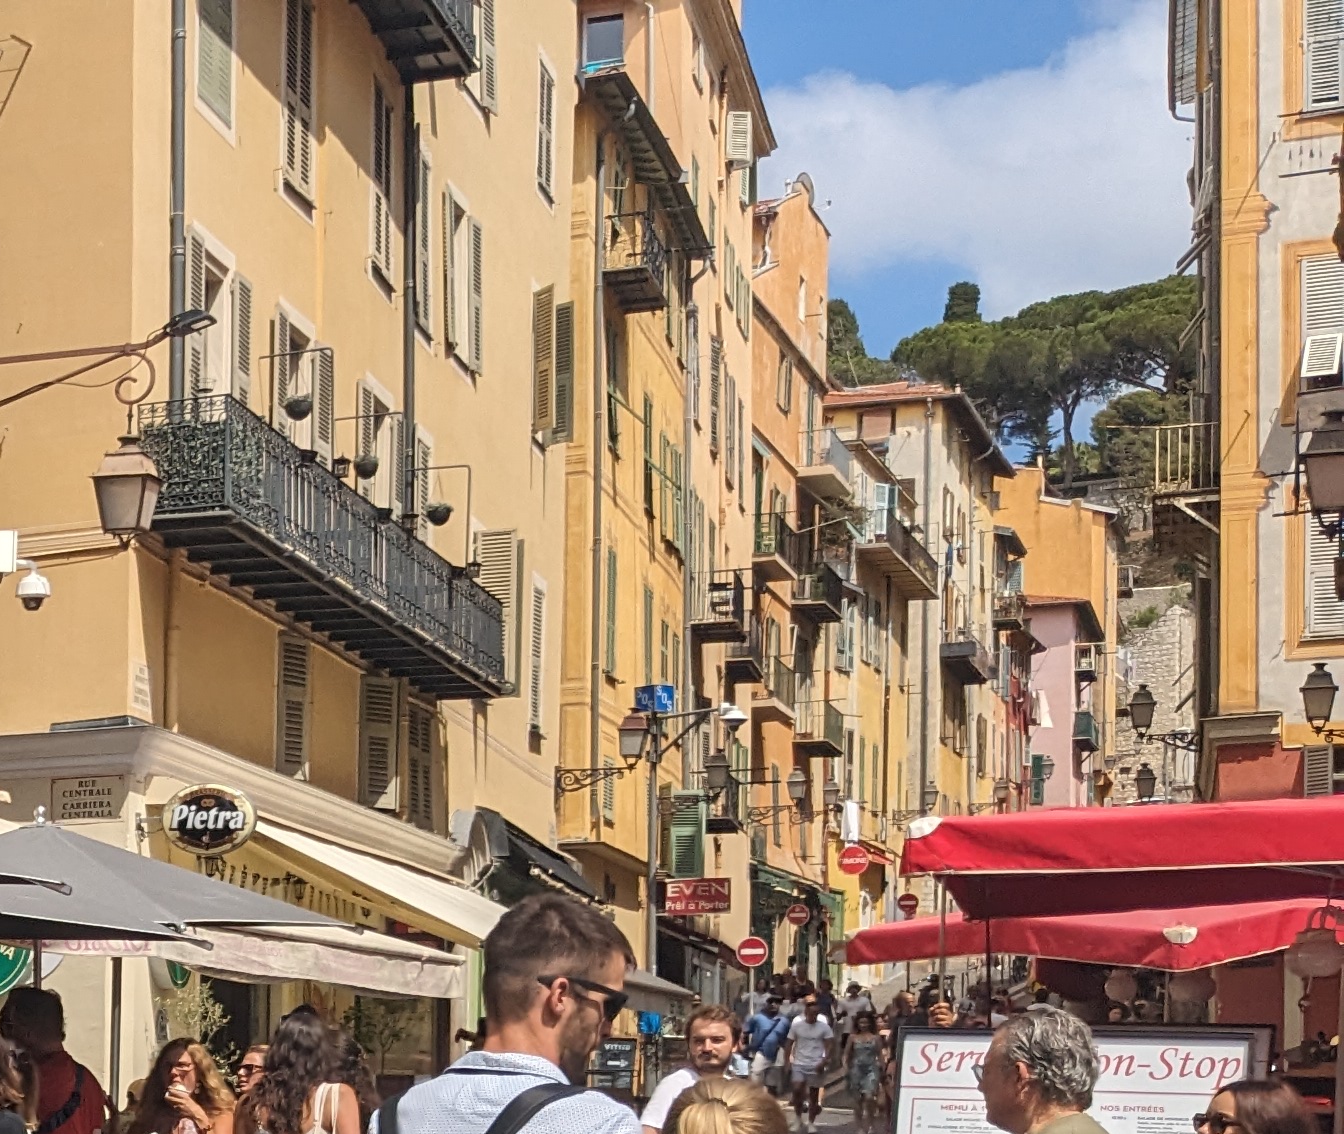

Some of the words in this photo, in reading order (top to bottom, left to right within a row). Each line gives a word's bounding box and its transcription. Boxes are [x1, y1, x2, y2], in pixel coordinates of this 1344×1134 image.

[656, 685, 673, 712] SOS
[78, 779, 96, 789] RUE
[62, 787, 112, 798] CENTRALE
[62, 799, 112, 811] CARRIERA
[61, 808, 113, 820] CENTRALA
[171, 804, 245, 831] Pietra
[666, 882, 729, 898] EVEN
[698, 900, 730, 910] Porter
[940, 1104, 968, 1112] MENU
[1122, 1103, 1165, 1113] ENTRÉES
